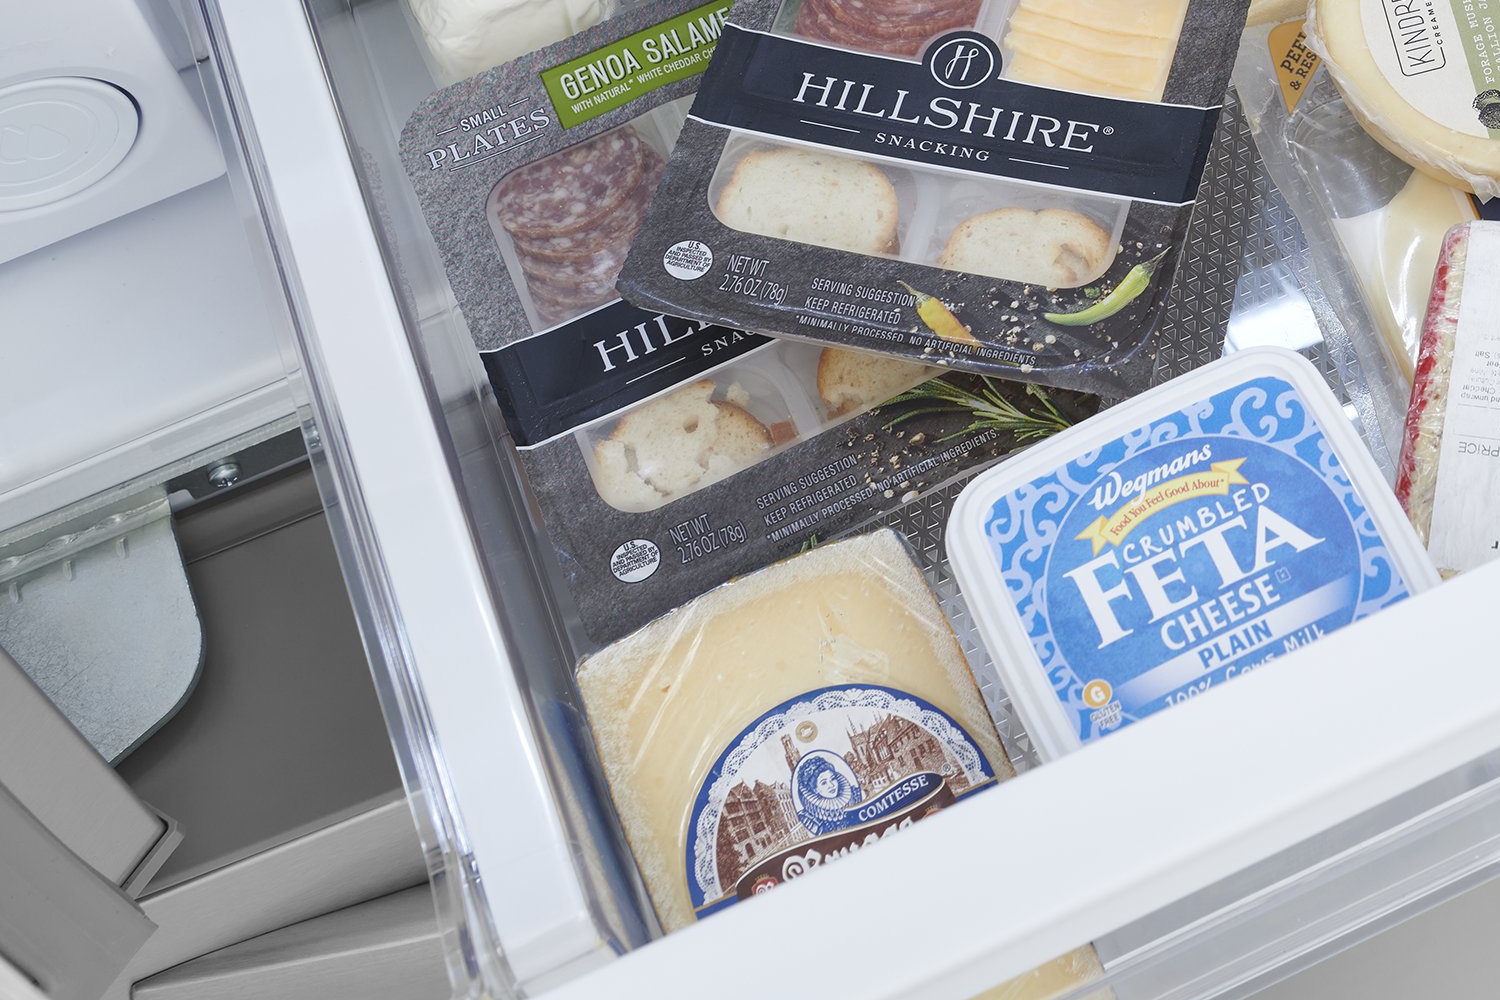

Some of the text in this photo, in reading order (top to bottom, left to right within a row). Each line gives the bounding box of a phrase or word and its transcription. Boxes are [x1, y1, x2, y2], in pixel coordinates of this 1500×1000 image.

[560, 48, 642, 100] GENOA
[1473, 34, 1495, 83] FORAGE
[571, 96, 593, 114] WITH
[637, 68, 663, 84] WHITE
[665, 53, 702, 73] CHEDDAR
[459, 104, 508, 132] SMALL
[794, 72, 1100, 154] HILLSHIRE
[425, 108, 551, 170] PLATES
[874, 131, 991, 162] SNACKING
[719, 274, 789, 305] 2.76 OZ (78g)
[727, 255, 770, 277] NET WT
[805, 297, 900, 324] KEEP REFRIGERATED
[812, 278, 917, 307] SERVING SUGGESTION
[1458, 442, 1500, 457] PRICE
[1088, 444, 1212, 511] Wegmans
[1110, 483, 1189, 536] Food You Feel Good
[1123, 482, 1270, 563] CRUMBLED
[1062, 505, 1327, 650] FETA
[1160, 574, 1281, 650] CHEESE
[1198, 620, 1273, 669] PLAIN
[858, 774, 929, 823] COMTESSE
